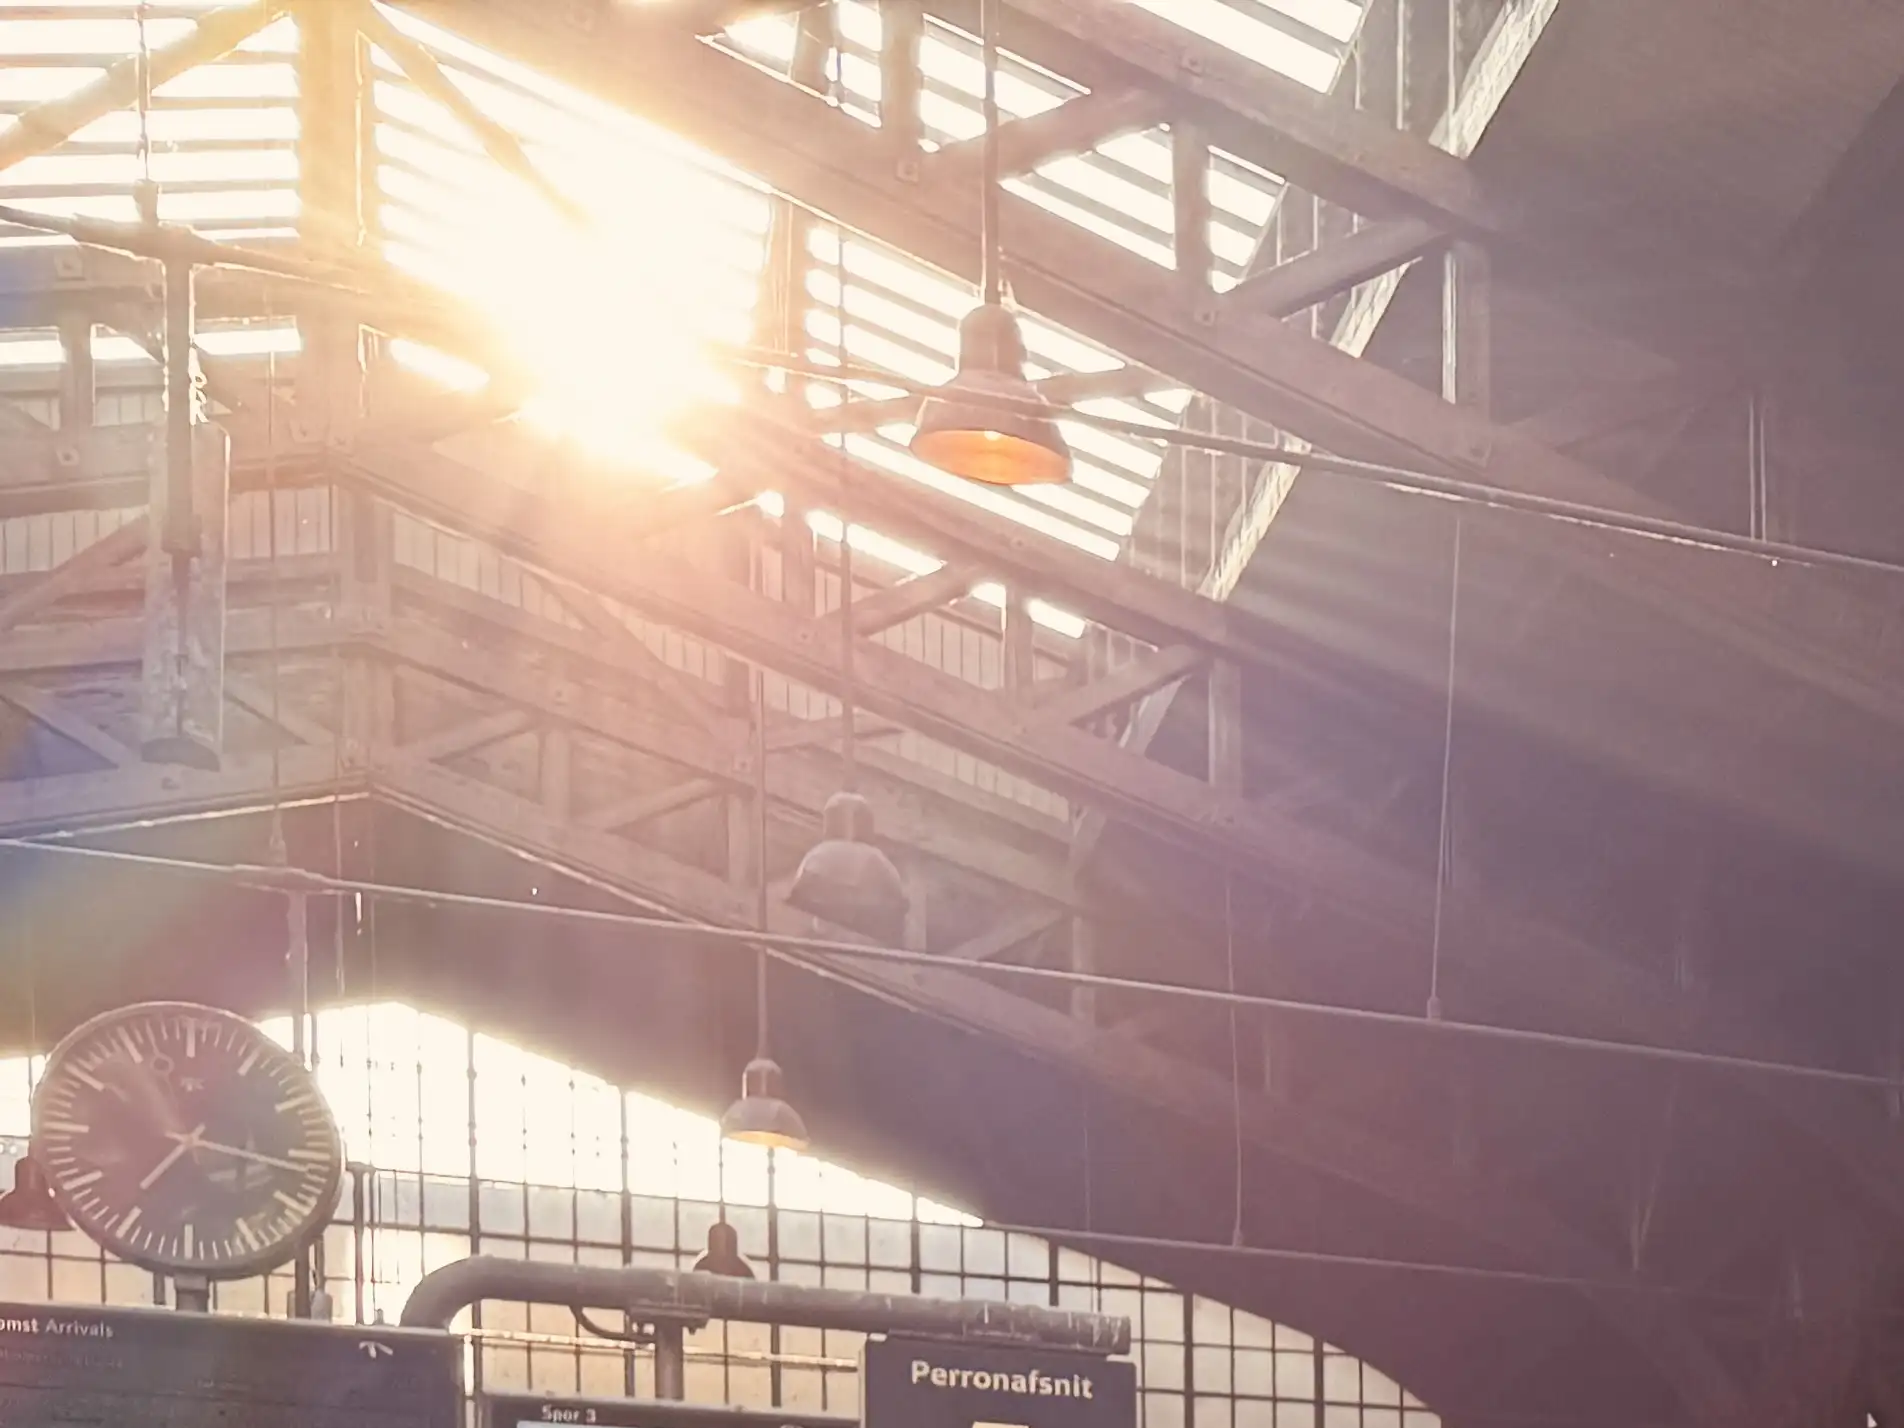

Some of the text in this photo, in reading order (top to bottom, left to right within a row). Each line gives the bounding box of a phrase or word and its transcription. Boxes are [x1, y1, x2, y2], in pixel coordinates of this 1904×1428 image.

[45, 1317, 114, 1339] Arrivals
[911, 1360, 1094, 1400] Perronafsnit
[542, 1404, 597, 1424] Spor 3
